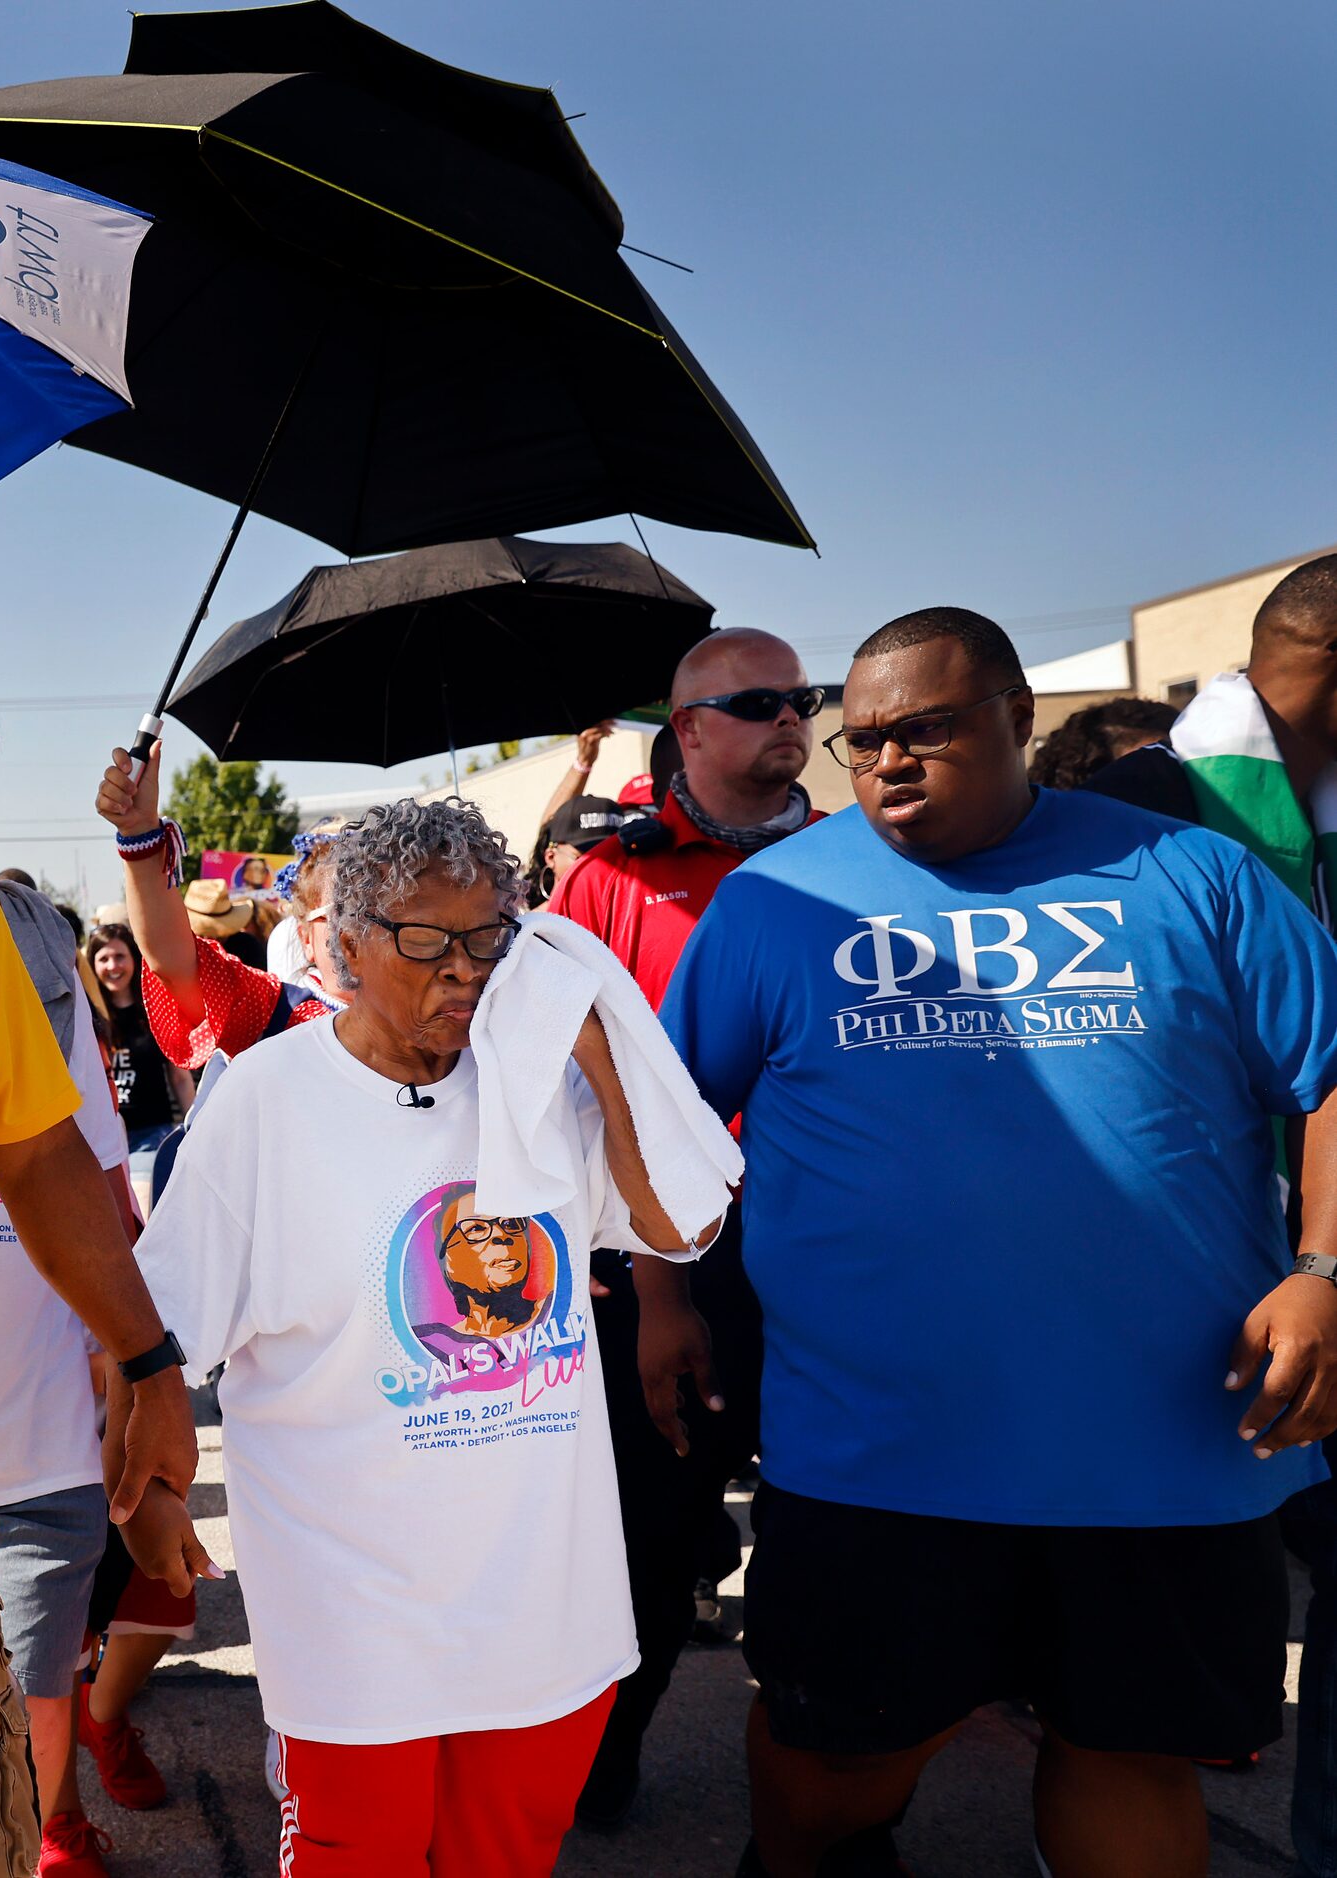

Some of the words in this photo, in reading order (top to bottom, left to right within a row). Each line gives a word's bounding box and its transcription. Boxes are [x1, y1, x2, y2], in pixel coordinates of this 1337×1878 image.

[645, 896, 654, 905] D.
[656, 891, 688, 903] EASON
[829, 1012, 908, 1048] PHI
[909, 1002, 1018, 1036] BETA
[1021, 999, 1149, 1034] SIGMA
[895, 1041, 930, 1051] Culture
[932, 1039, 947, 1049] for
[948, 1039, 984, 1050] Service,
[985, 1039, 1018, 1049] Service
[1020, 1040, 1036, 1049] for
[1037, 1037, 1087, 1049] Humanity
[403, 1411, 449, 1428] JUNE
[455, 1408, 476, 1423] 19,
[481, 1401, 513, 1420] 2021
[404, 1432, 432, 1442] FORT
[434, 1428, 471, 1440] WORTH
[481, 1424, 498, 1434] NYC
[505, 1412, 565, 1428] WASHINGTON
[411, 1440, 458, 1451] ATLANTA
[468, 1432, 505, 1447] DETROIT
[511, 1428, 529, 1438] LOS
[531, 1422, 577, 1435] ANGELES
